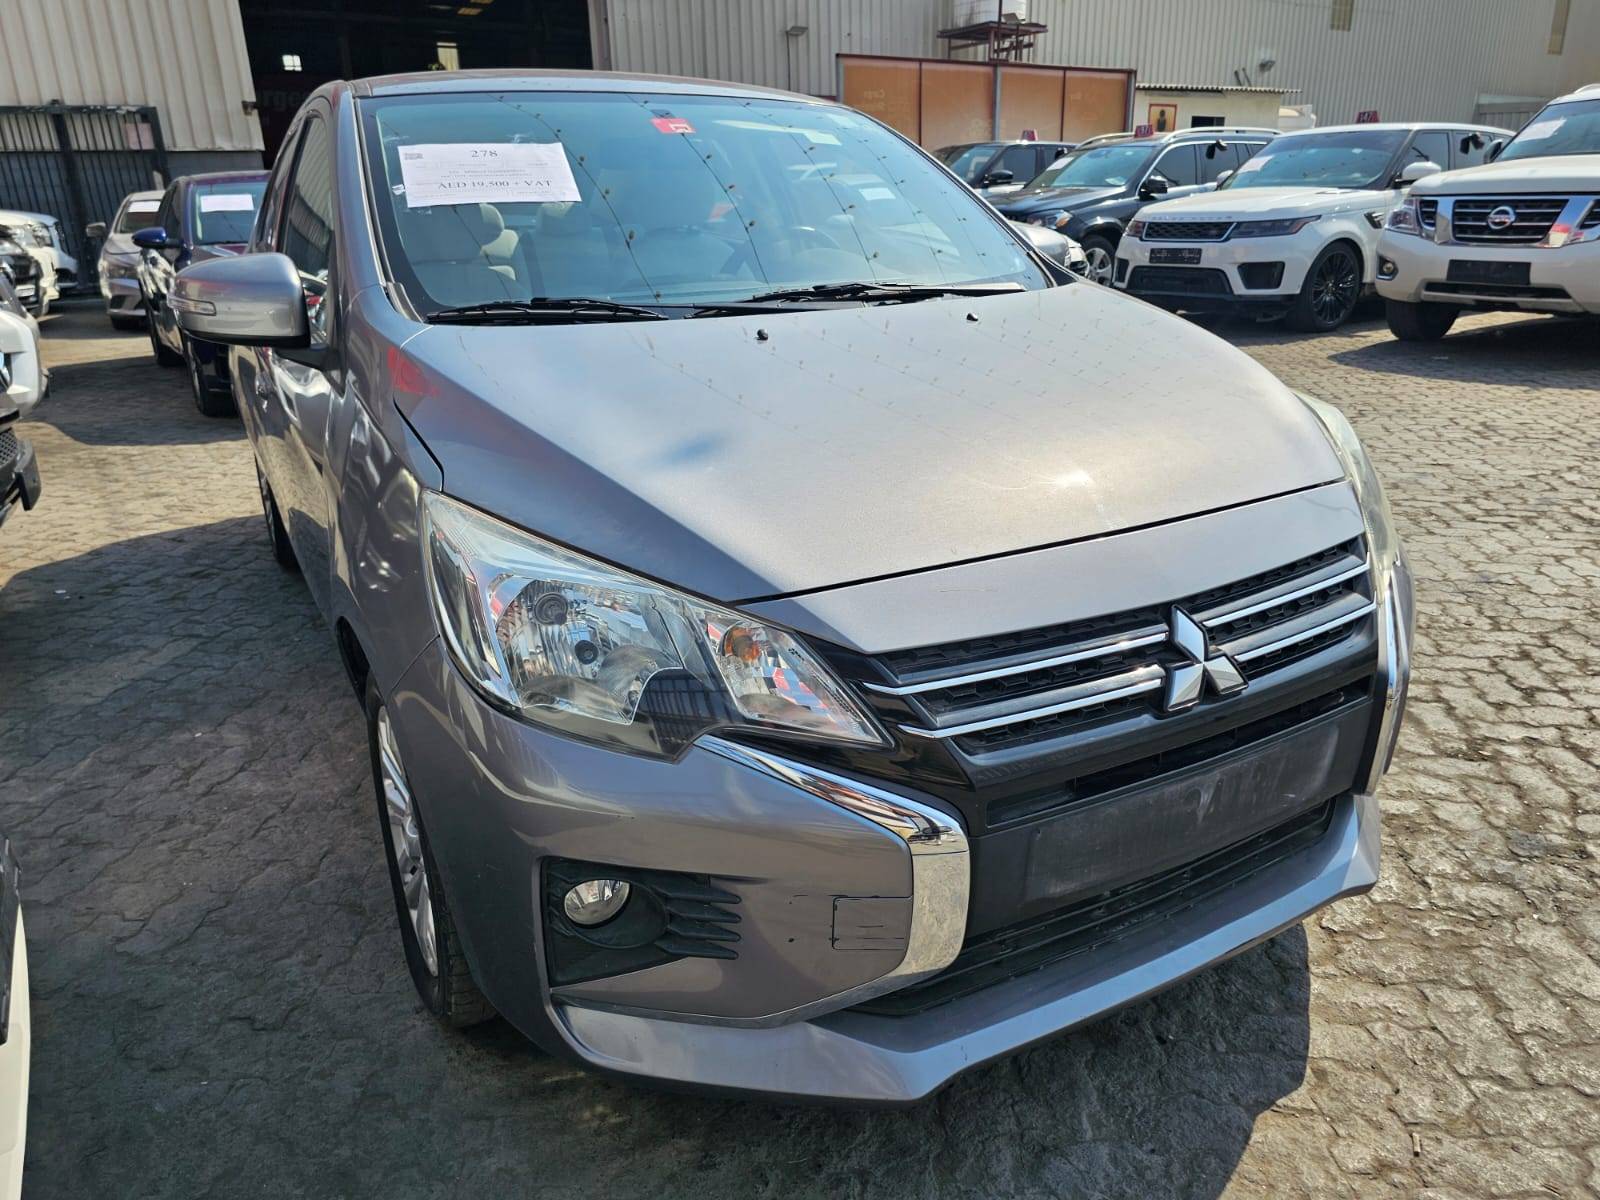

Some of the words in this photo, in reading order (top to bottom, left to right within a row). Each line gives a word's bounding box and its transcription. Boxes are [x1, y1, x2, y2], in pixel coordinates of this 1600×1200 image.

[471, 150, 499, 158] 278
[438, 180, 467, 190] AED
[472, 180, 510, 189] 19,500
[524, 179, 554, 188] VAT
